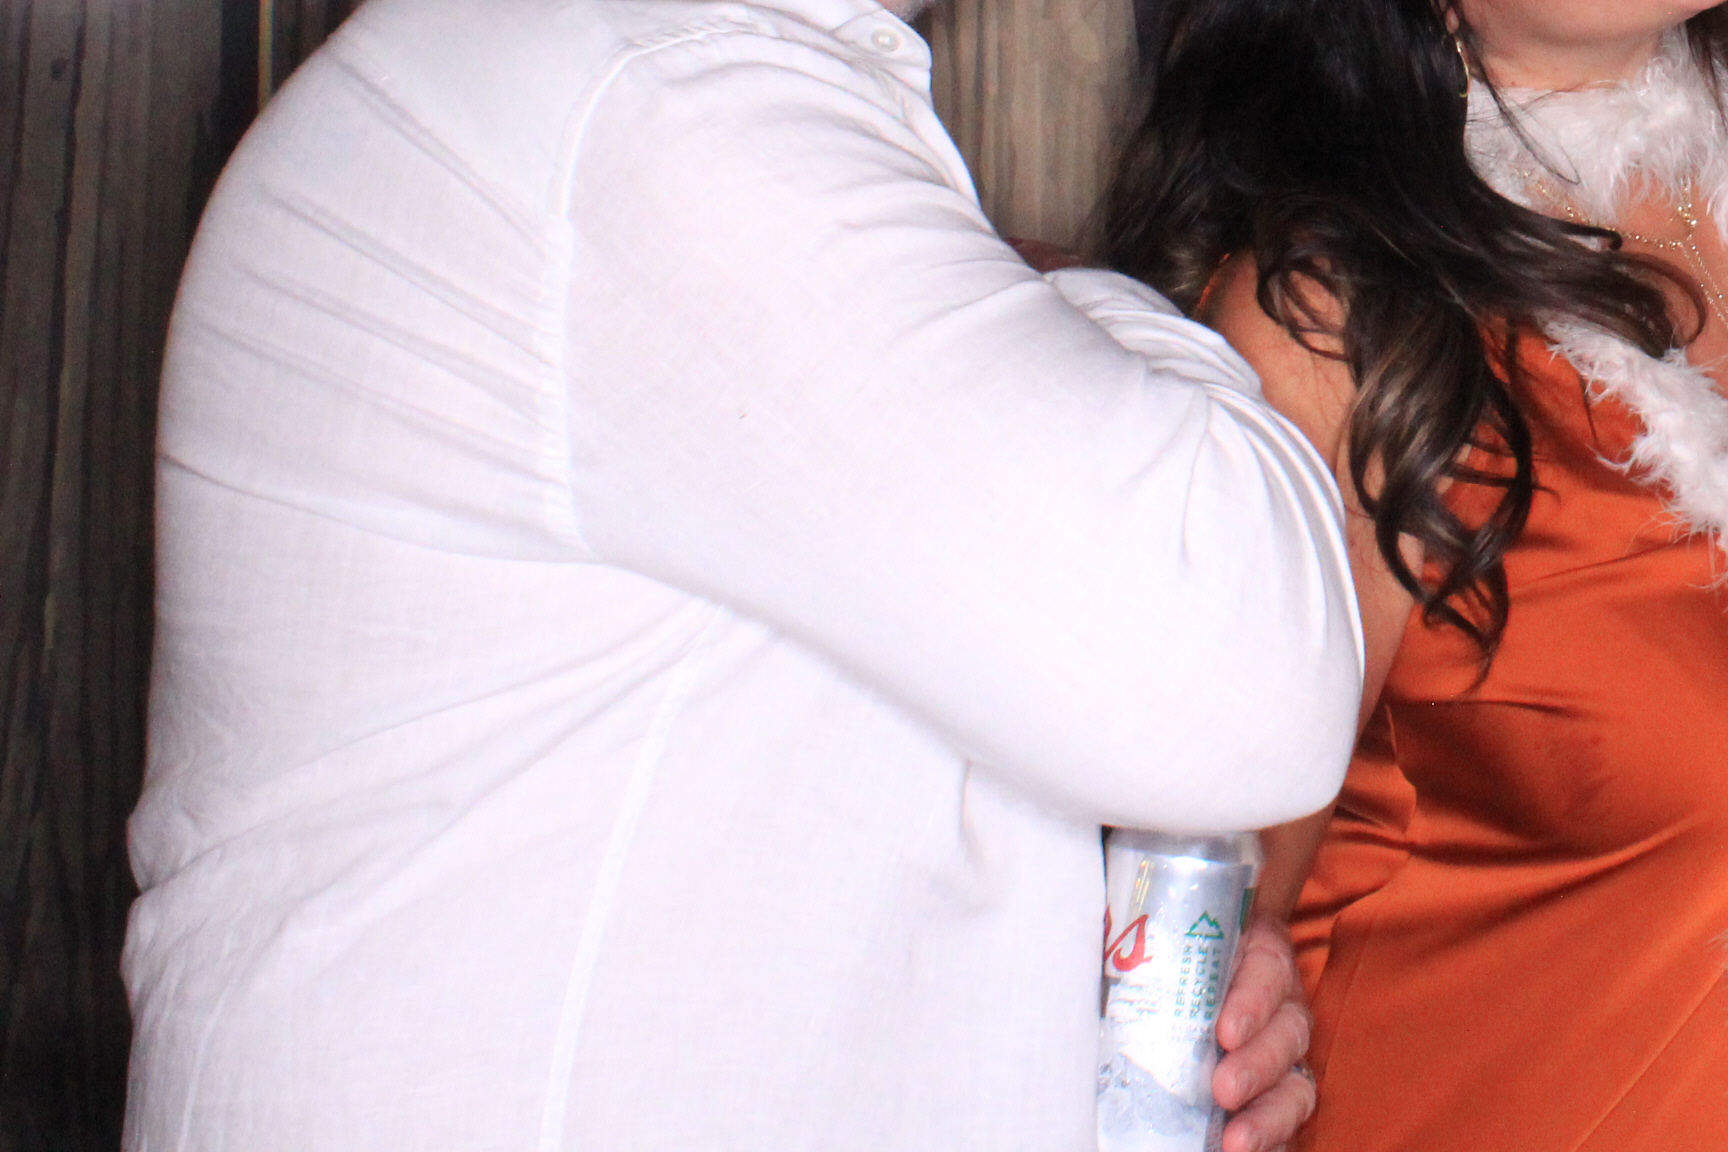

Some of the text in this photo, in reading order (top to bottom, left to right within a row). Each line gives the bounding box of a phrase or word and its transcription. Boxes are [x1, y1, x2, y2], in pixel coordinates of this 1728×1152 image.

[1174, 944, 1193, 1017] REFRESH
[1190, 946, 1208, 1019] RECYCLE
[1204, 947, 1220, 1020] REPEAT
